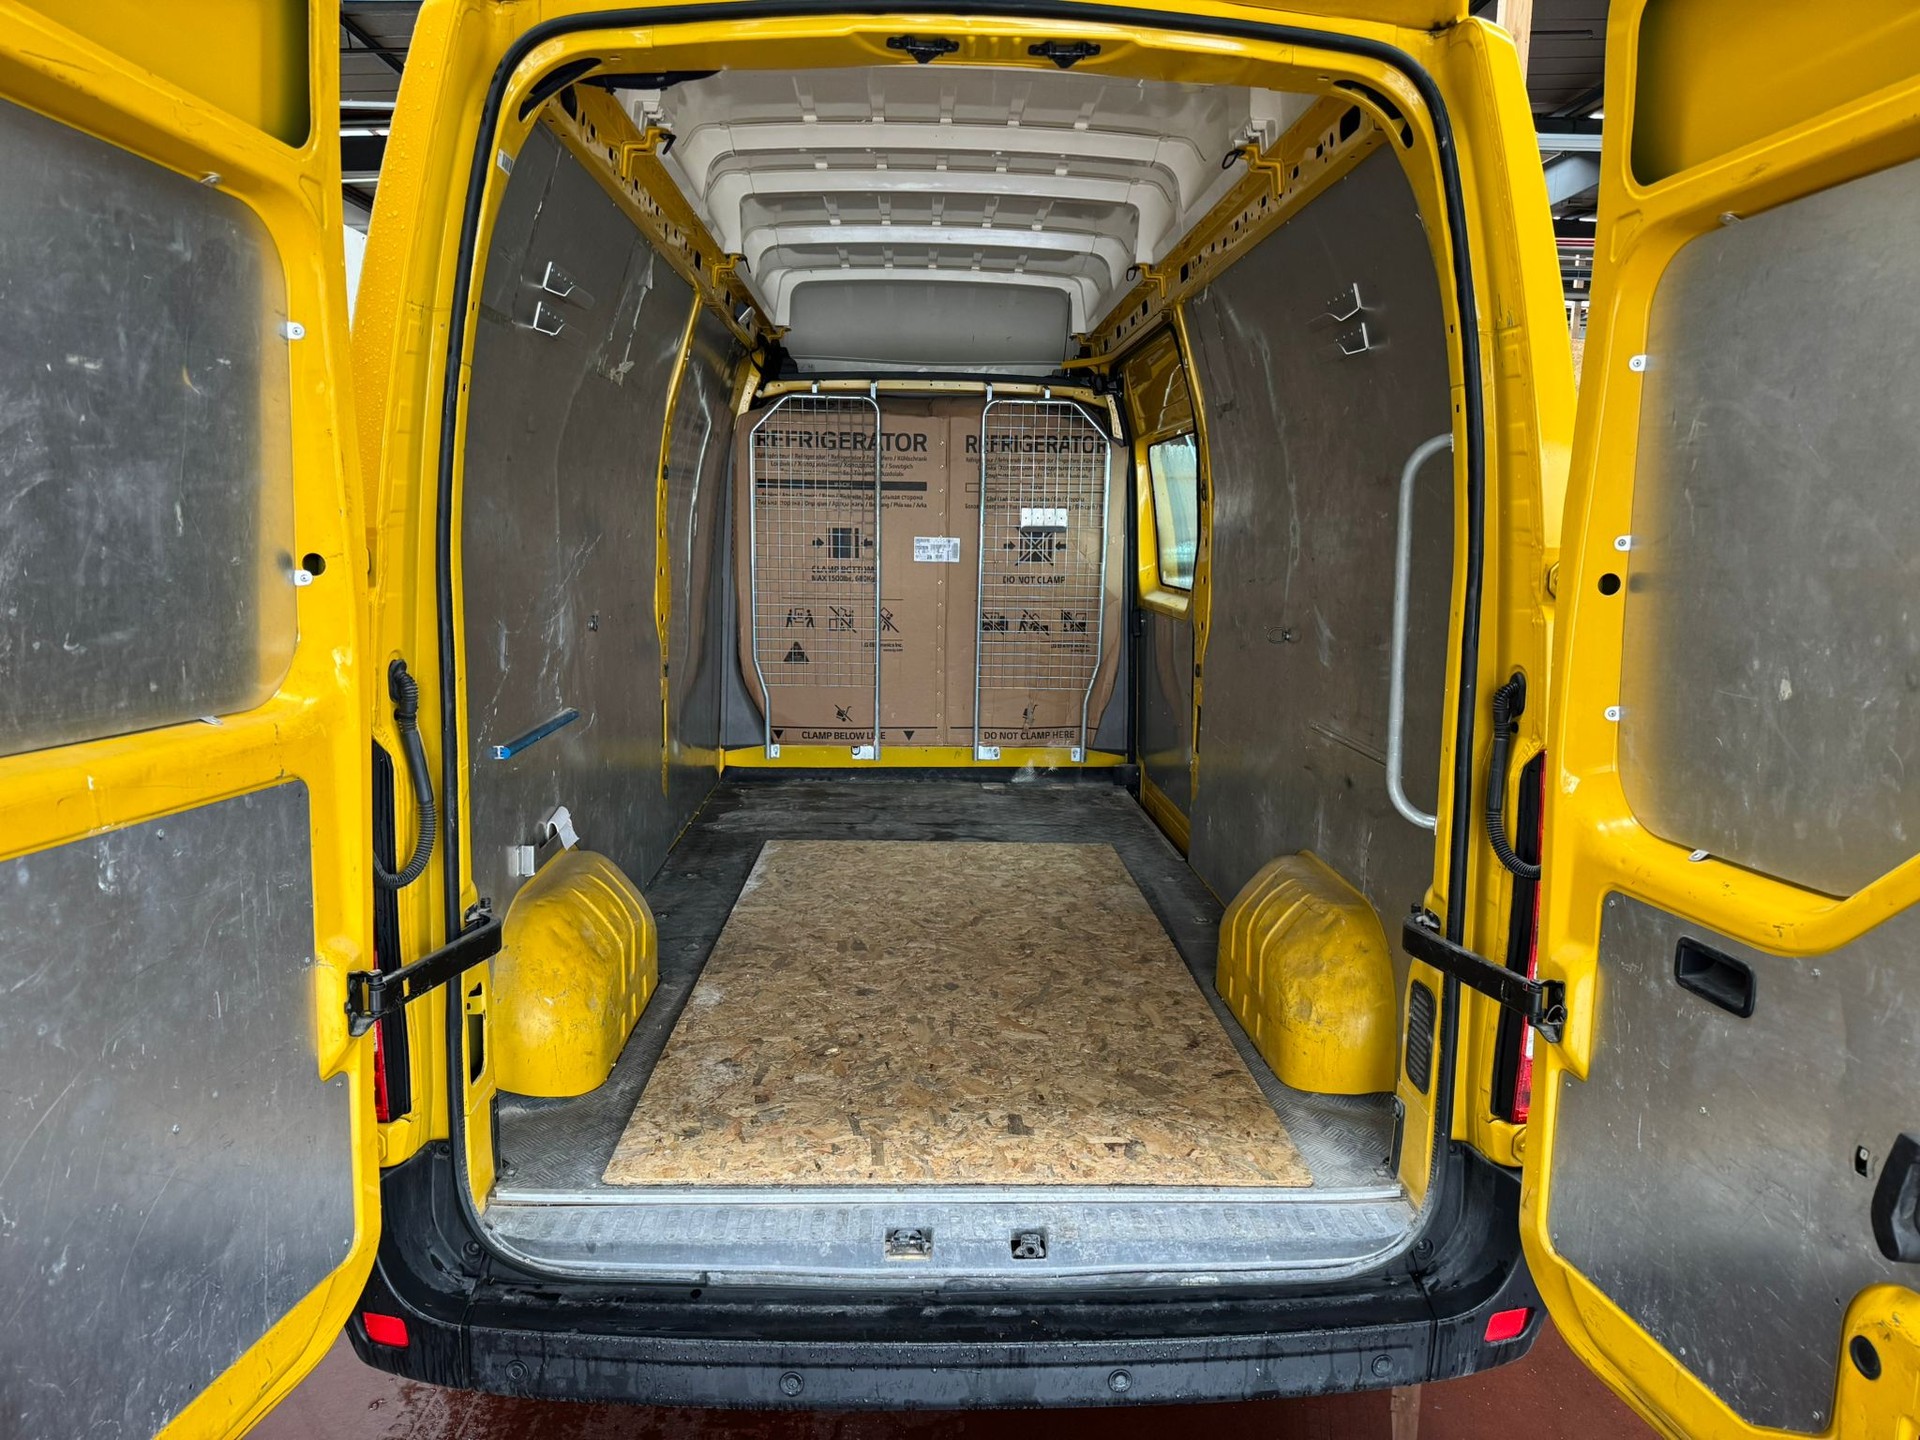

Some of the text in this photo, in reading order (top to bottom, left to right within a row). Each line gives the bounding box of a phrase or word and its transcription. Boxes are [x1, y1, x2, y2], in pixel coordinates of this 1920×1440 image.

[756, 430, 927, 452] REFRIGERATOR
[1003, 576, 1066, 584] DO NOT CLAMP
[801, 731, 886, 740] CLAMP BELOW LIE
[984, 730, 1075, 740] DO NOT CLAMP HERE
